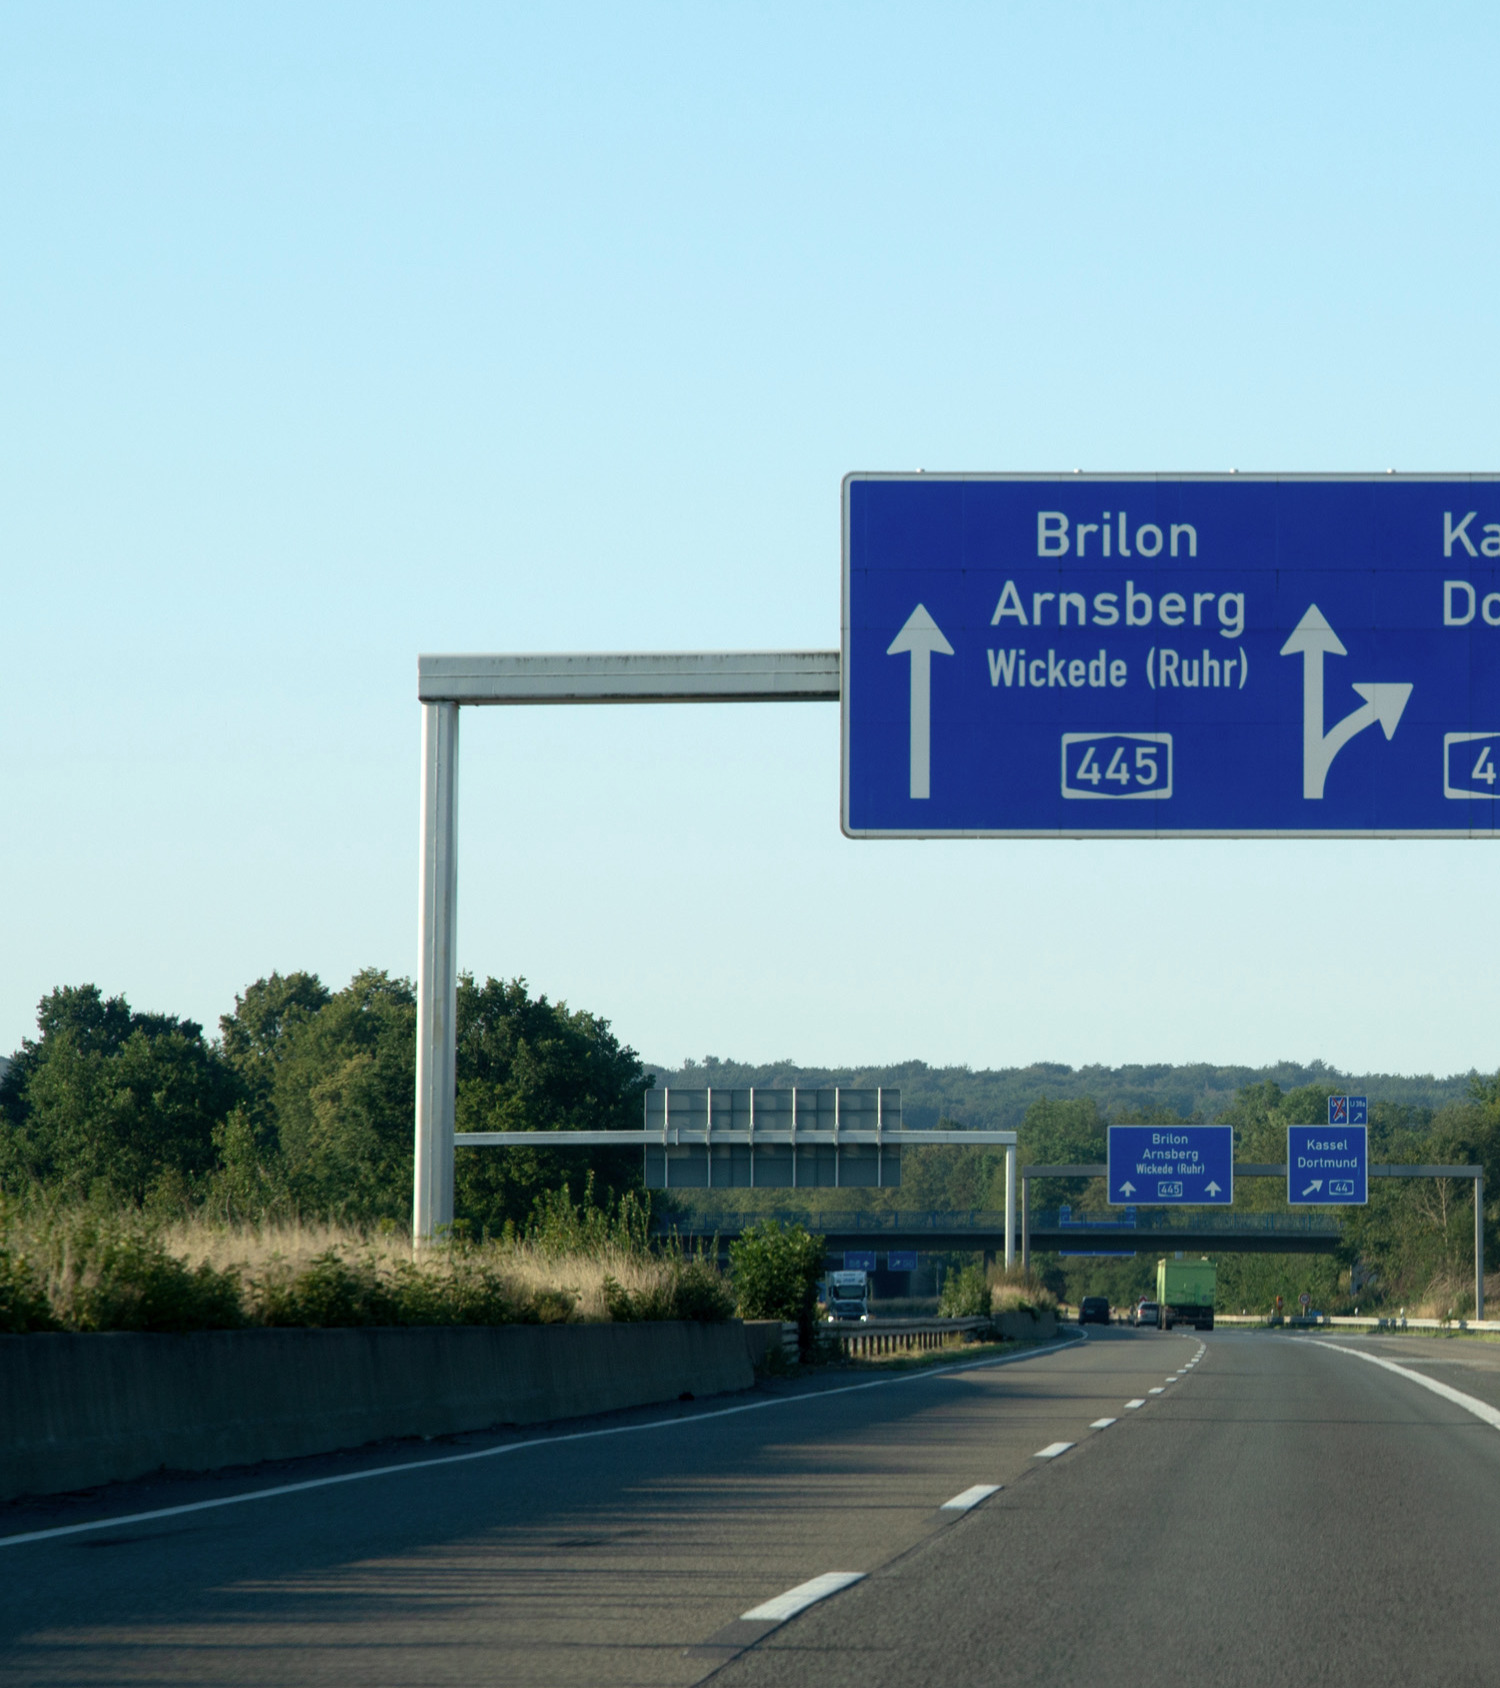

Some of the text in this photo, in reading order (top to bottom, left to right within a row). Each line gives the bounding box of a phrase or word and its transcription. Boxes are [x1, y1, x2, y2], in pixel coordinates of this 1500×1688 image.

[1037, 511, 1198, 558] Brilon
[990, 579, 1246, 639] Arnsberg
[986, 646, 1249, 691] Wickede (Ruhr)
[1075, 746, 1158, 786] 445
[1152, 1133, 1189, 1145] Brilon
[1307, 1139, 1348, 1151] Kassel
[1142, 1148, 1199, 1162] Arnsberg
[1297, 1156, 1358, 1168] Dortmund
[1136, 1163, 1205, 1175] Wickede (Ruhr)
[1161, 1184, 1180, 1194] 445
[1335, 1183, 1348, 1192] 44
